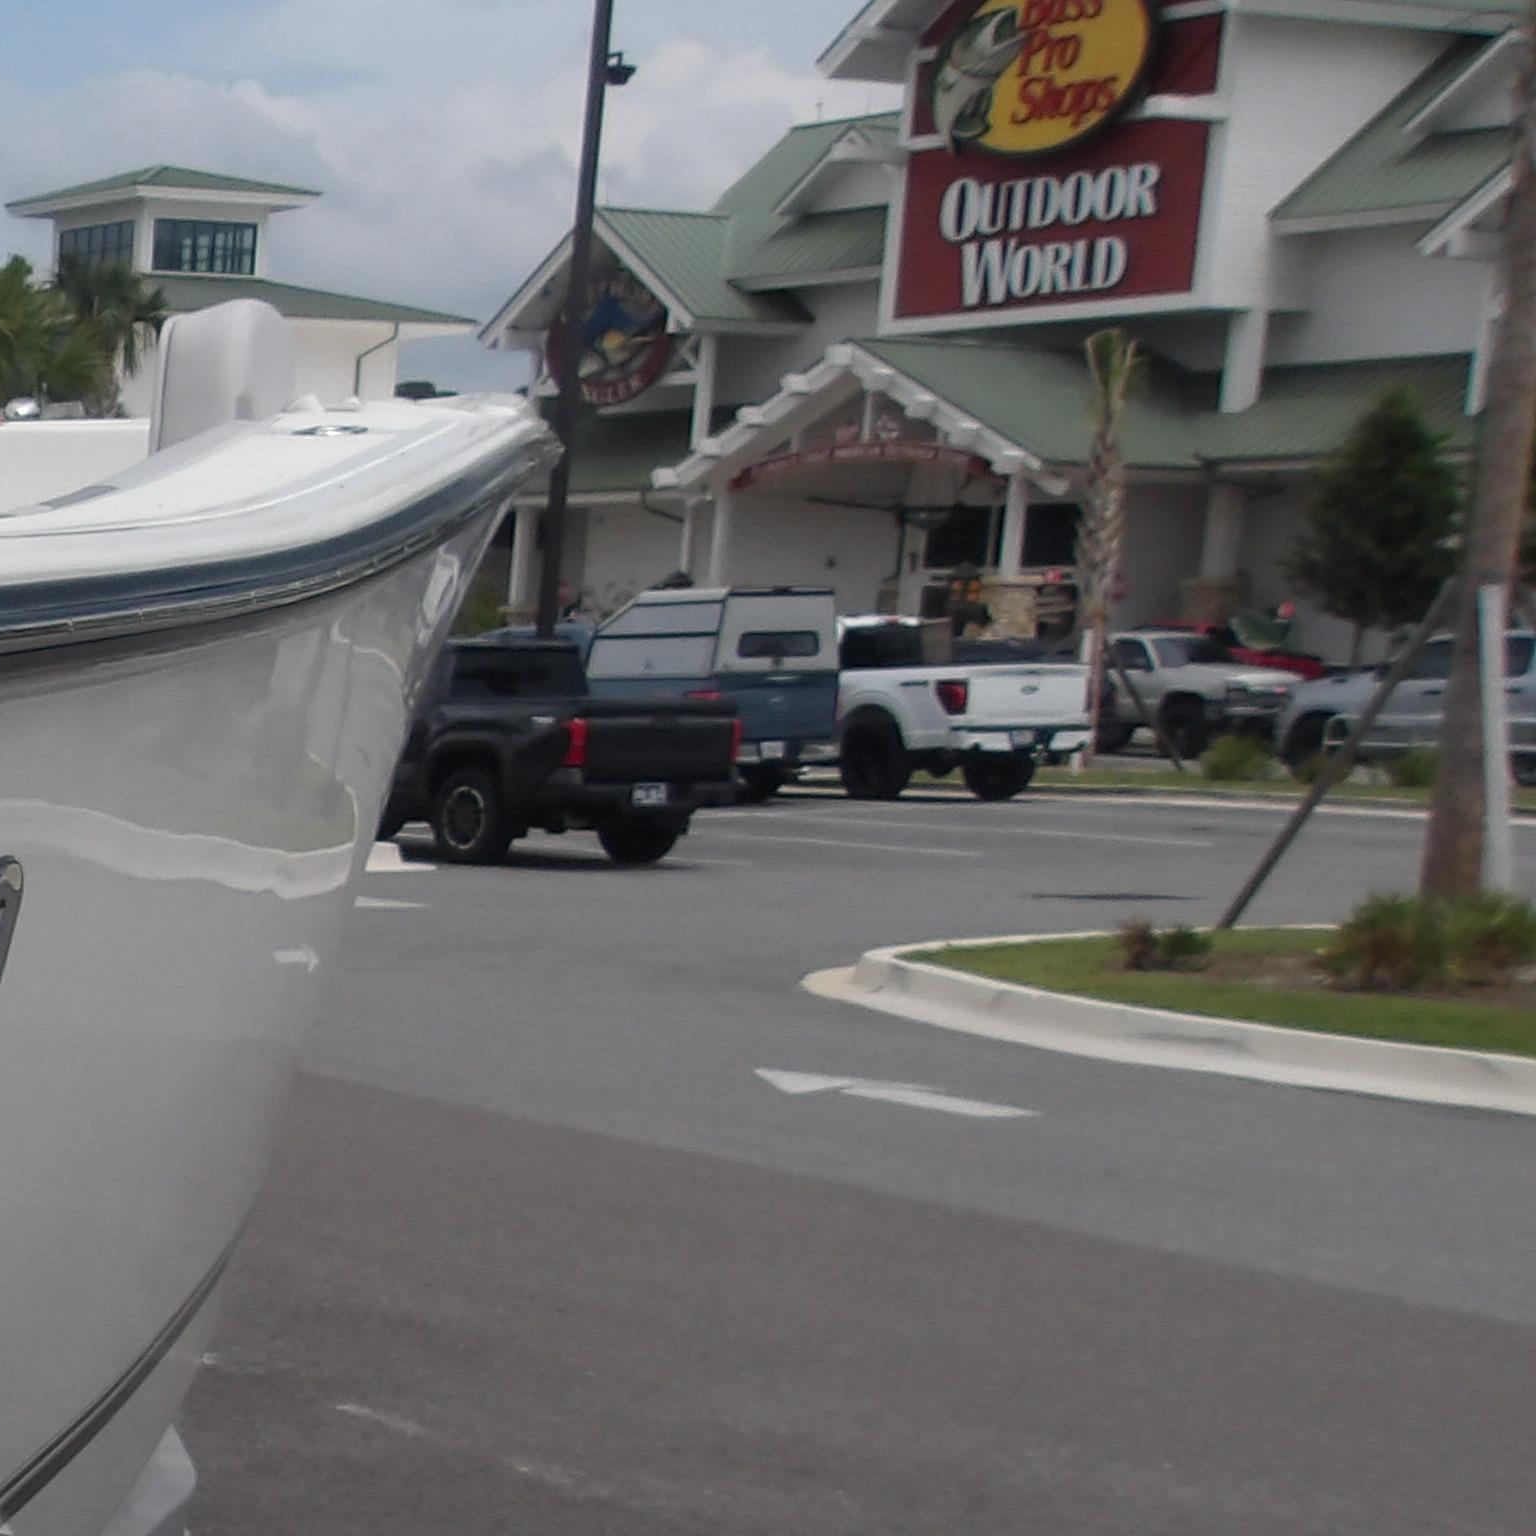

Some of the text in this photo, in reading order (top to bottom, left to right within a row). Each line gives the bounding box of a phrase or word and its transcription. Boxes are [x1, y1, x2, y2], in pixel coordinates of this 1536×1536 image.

[1018, 29, 1082, 78] Pro
[1011, 75, 1118, 128] Shops
[940, 162, 1162, 243] OUTDOOR
[960, 235, 1129, 309] WORLD
